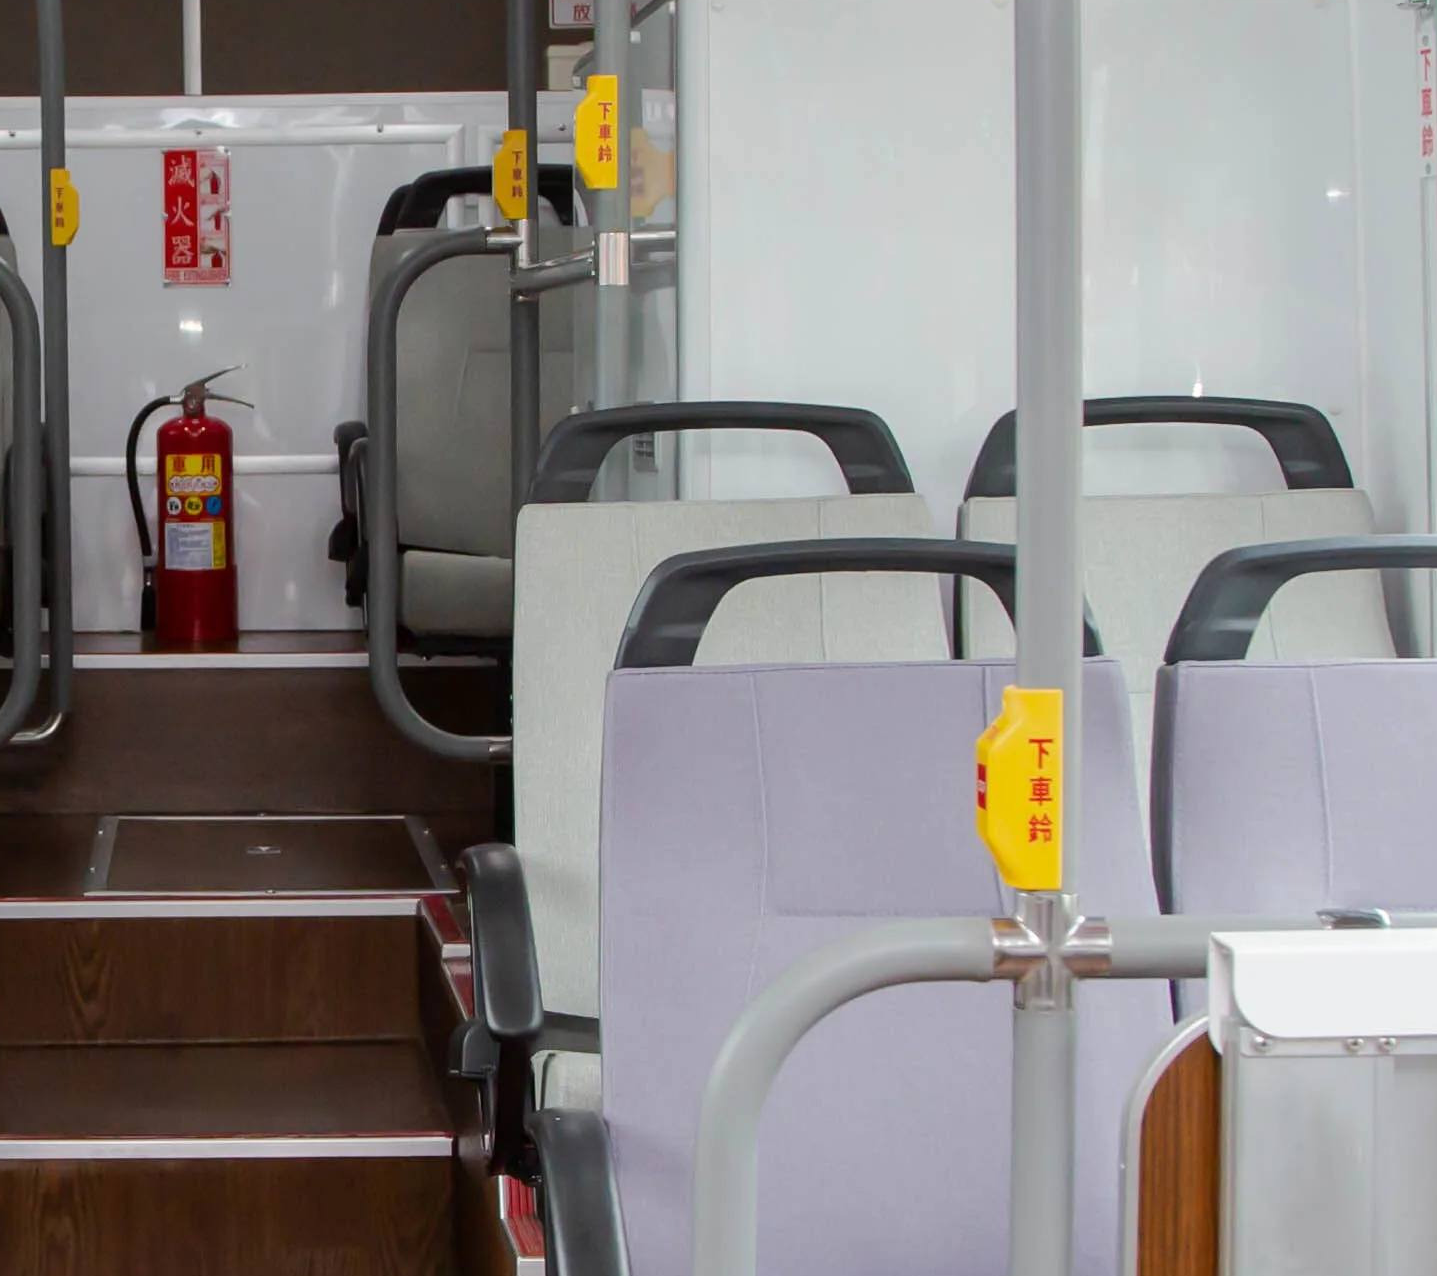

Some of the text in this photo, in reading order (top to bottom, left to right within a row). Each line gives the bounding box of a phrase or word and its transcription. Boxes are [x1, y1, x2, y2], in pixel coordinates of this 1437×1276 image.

[597, 102, 613, 163] 下車鈴
[168, 154, 195, 266] 滅火器
[1028, 738, 1053, 843] 下車鈴
